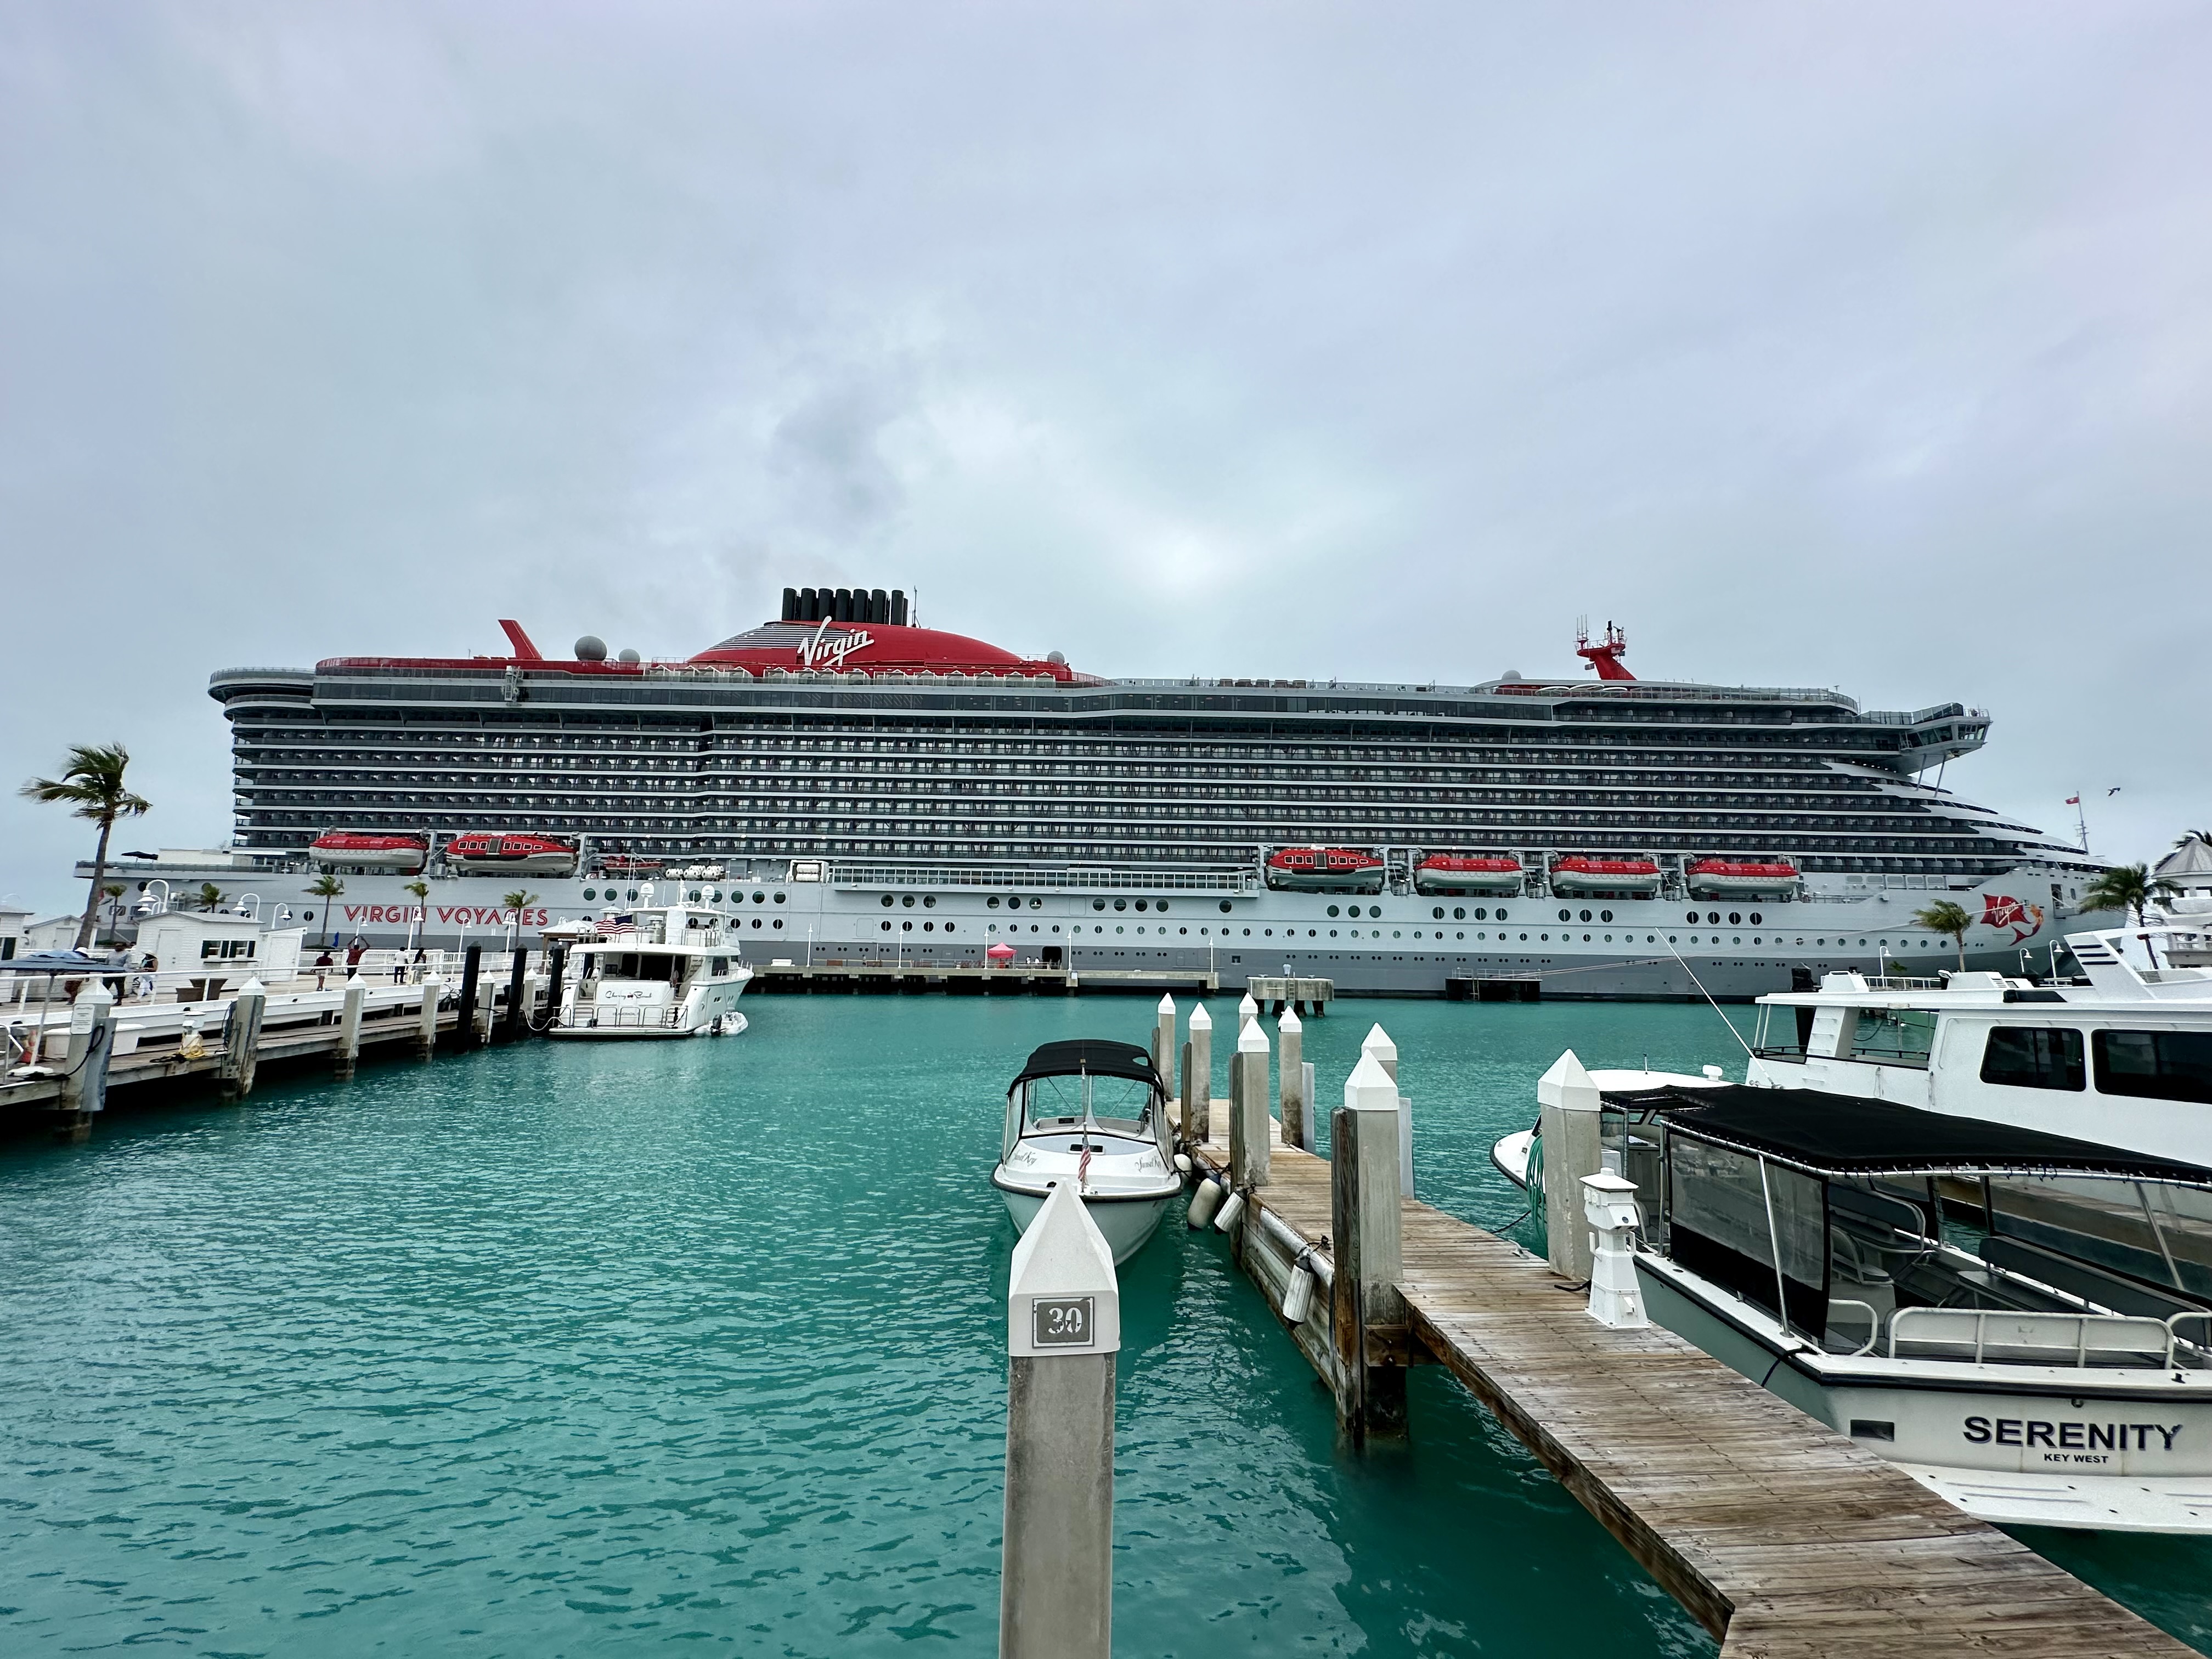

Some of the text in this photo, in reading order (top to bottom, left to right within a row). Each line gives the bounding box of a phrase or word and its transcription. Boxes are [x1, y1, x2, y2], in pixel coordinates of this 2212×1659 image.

[797, 616, 874, 666] Virgin
[344, 905, 427, 923] VIRGIN
[1991, 896, 2019, 925] Virgin
[1048, 1307, 1082, 1334] 30
[1963, 1417, 2183, 1451] SERENITY
[2044, 1454, 2108, 1464] KEY WEST
